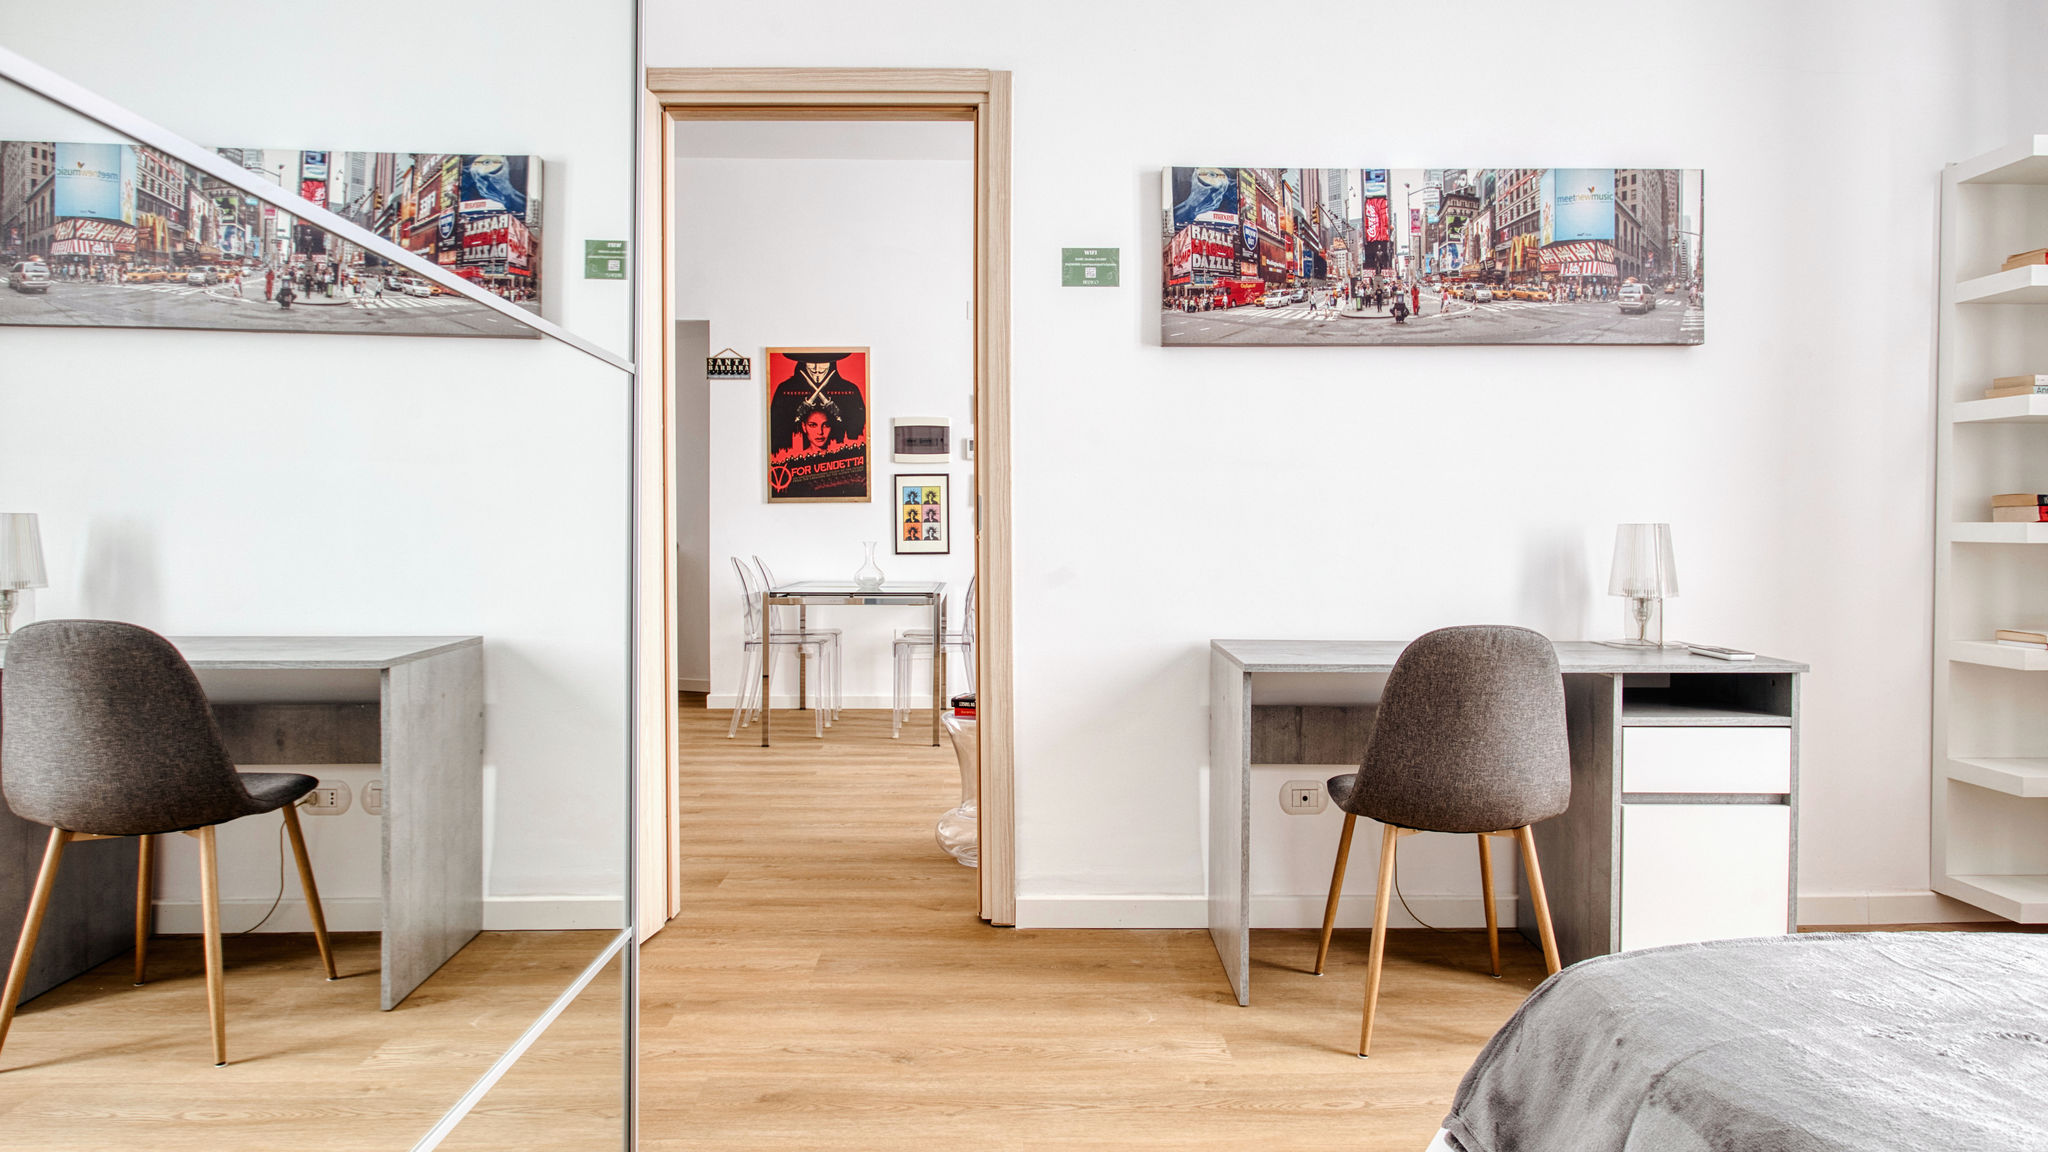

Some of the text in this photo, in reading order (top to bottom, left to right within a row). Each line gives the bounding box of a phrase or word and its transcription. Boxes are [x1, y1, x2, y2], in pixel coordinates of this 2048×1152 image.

[1261, 203, 1278, 234] FREE
[1192, 225, 1234, 247] RAZZLE
[1192, 254, 1234, 270] DAZZLE
[708, 358, 749, 366] SANTA
[770, 464, 790, 493] V
[791, 465, 811, 477] FOR
[813, 456, 864, 473] VENDETTA
